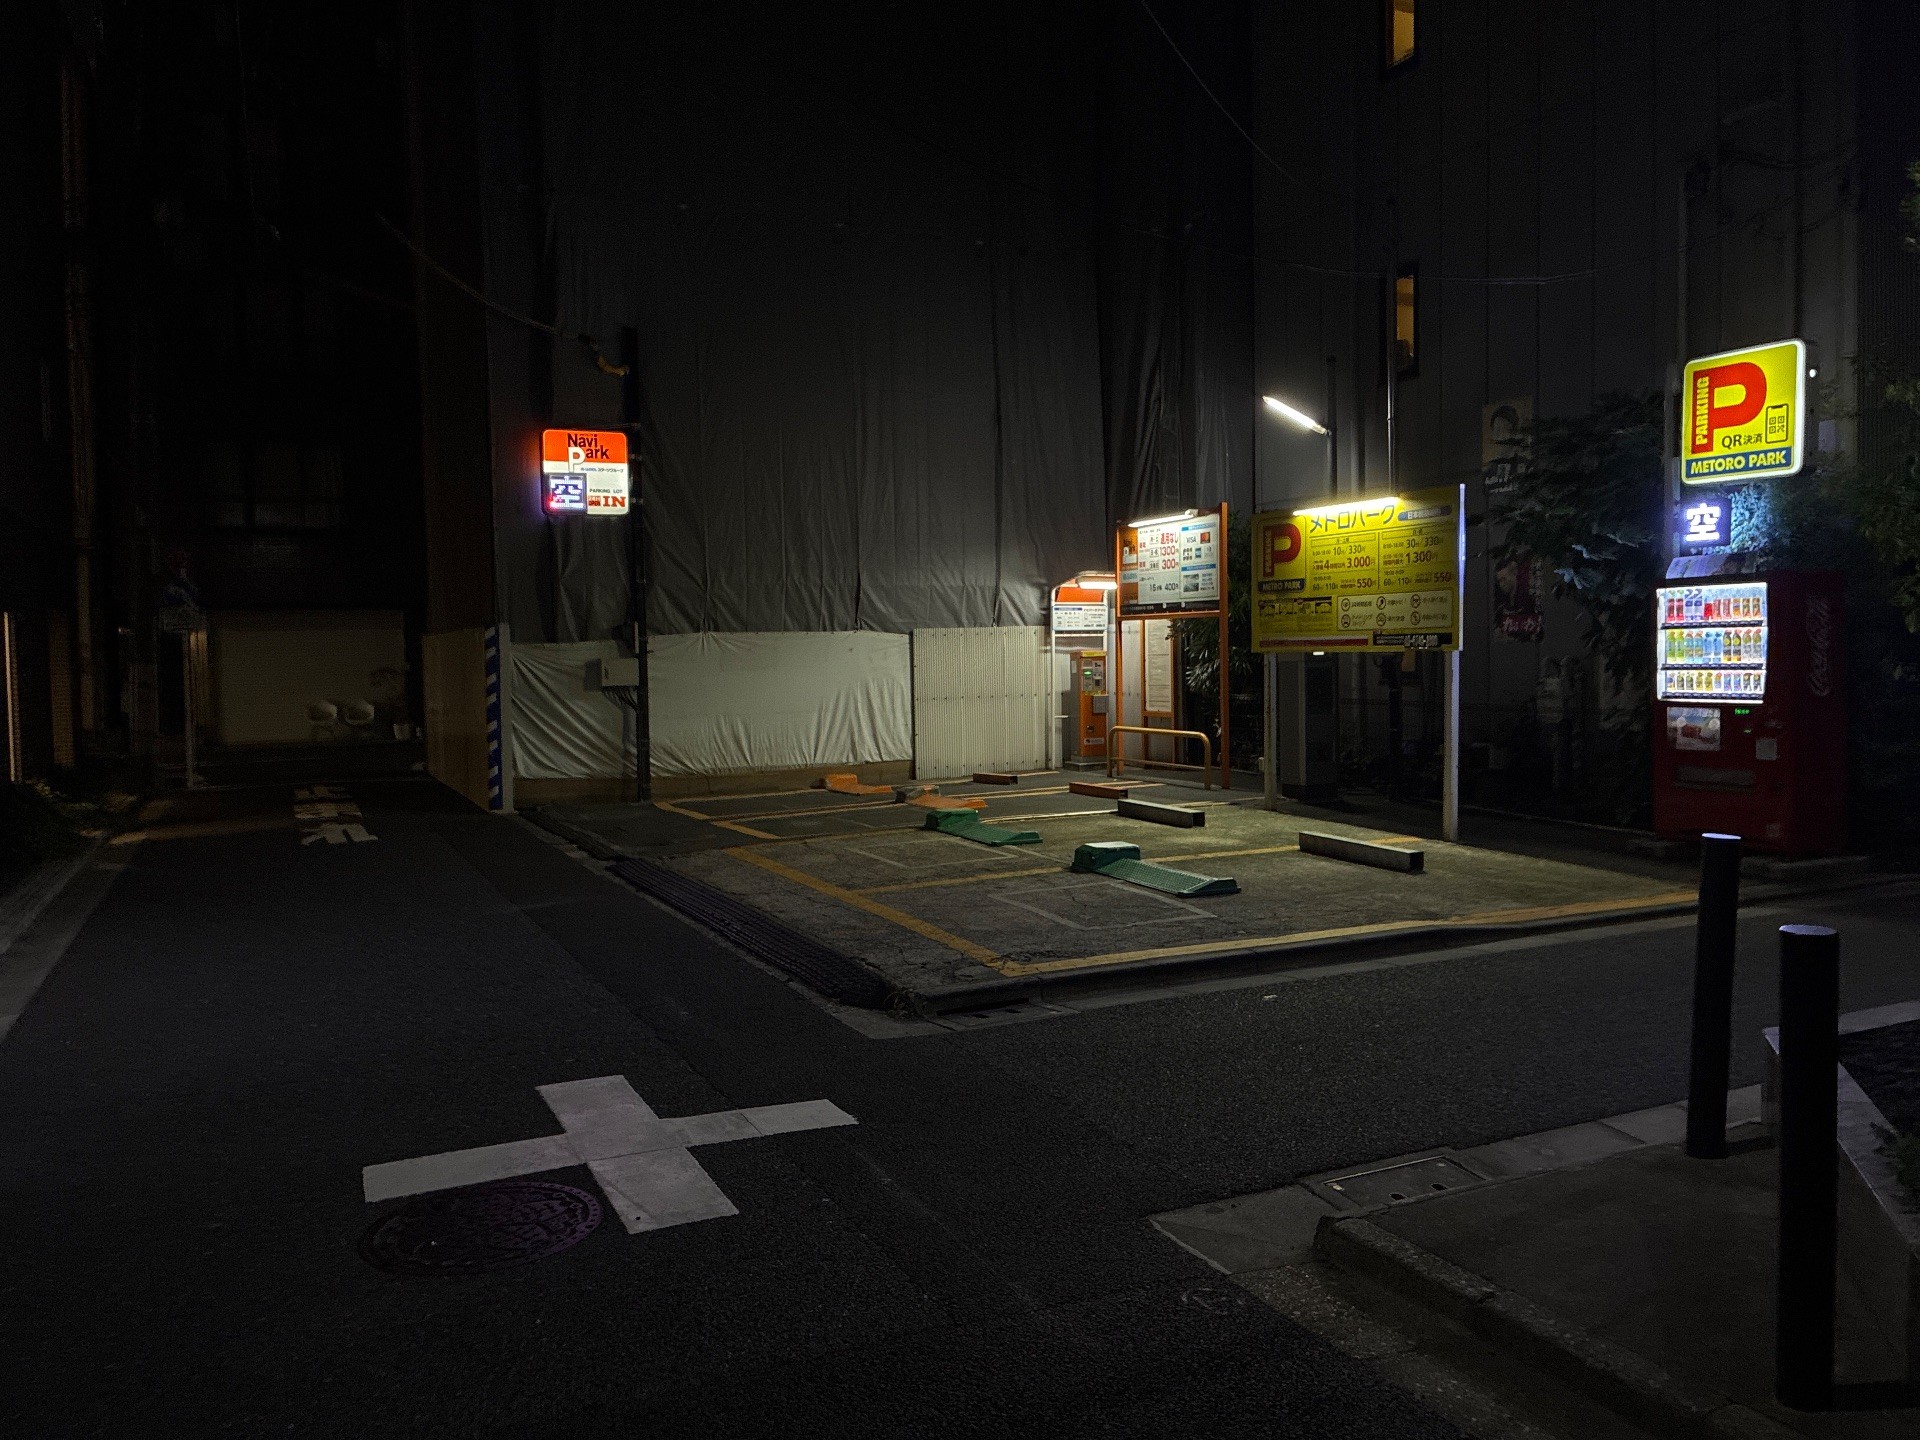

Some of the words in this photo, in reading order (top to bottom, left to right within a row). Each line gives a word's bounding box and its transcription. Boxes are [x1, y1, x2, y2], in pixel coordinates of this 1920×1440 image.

[1691, 362, 1767, 455] P
[1695, 376, 1709, 445] PARKING
[567, 433, 598, 447] Navi
[1721, 433, 1763, 450] QR決済
[567, 445, 610, 473] Park
[1690, 455, 1744, 475] METORO
[1748, 450, 1786, 468] PARK
[549, 475, 584, 509] 空
[602, 495, 626, 507] IN
[1685, 502, 1720, 541] 空
[1283, 580, 1301, 589] PARK
